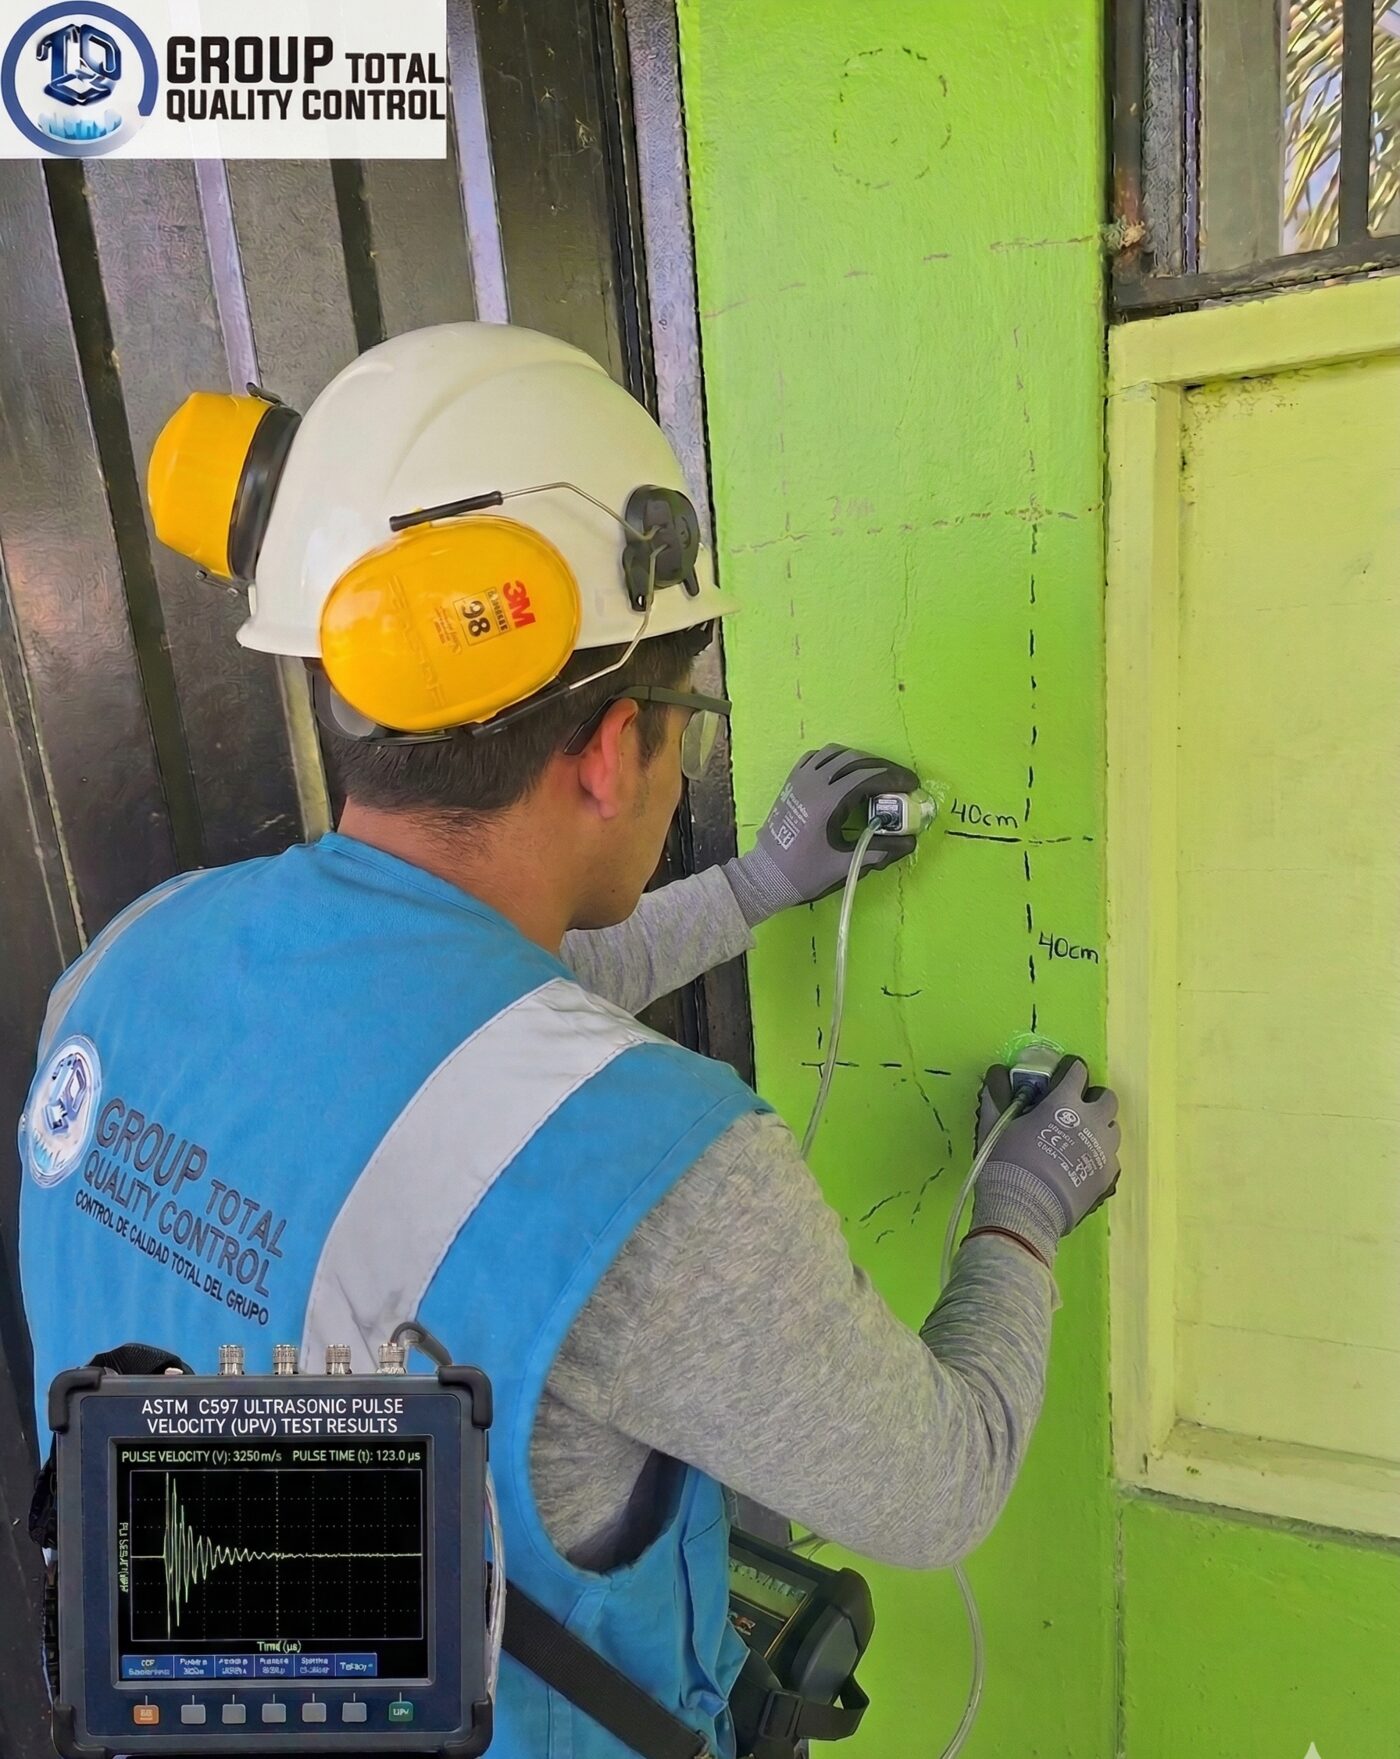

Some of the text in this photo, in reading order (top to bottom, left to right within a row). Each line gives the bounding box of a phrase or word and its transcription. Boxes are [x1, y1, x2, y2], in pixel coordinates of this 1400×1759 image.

[502, 580, 537, 629] 3M
[950, 798, 1018, 829] 40cm
[1038, 931, 1099, 964] 40cm
[96, 1097, 288, 1259] GROUP TOTAL
[83, 1149, 270, 1298] QUALITY CONTROL
[74, 1189, 270, 1326] CONTROL DE CALIDAD TOTAL DEL GRUPO
[141, 1399, 404, 1415] ASTM C597 ULTRASONIC PULSE
[147, 1418, 398, 1437] VELOCITY (UPV) TEST RESULTS
[121, 1451, 156, 1462] PULSE
[158, 1451, 210, 1462] VELOCITY
[212, 1451, 231, 1465] (V):
[292, 1451, 327, 1462] PULSE
[329, 1450, 356, 1461] TIME
[376, 1450, 406, 1461] 123.0
